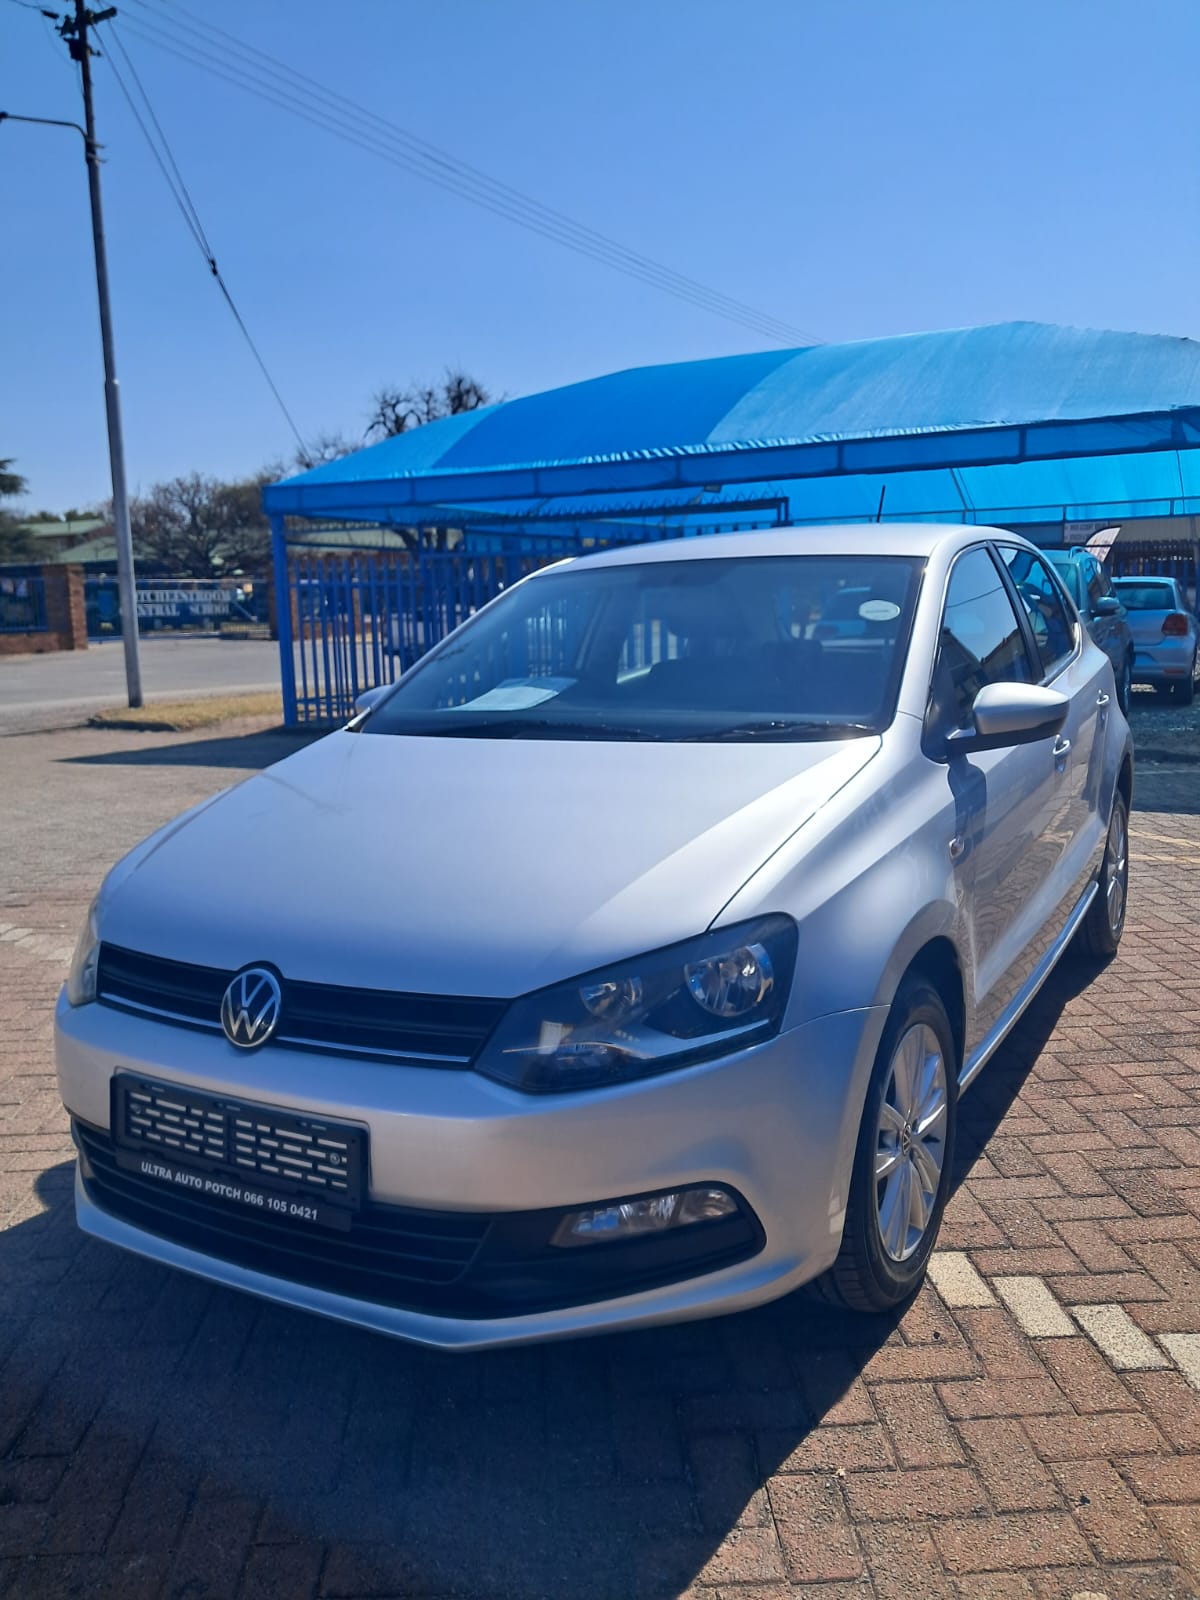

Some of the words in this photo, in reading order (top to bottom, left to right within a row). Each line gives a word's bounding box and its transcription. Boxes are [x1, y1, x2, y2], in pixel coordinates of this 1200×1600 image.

[140, 1161, 172, 1181] ULTRA
[174, 1171, 203, 1189] AUTO
[204, 1180, 241, 1200] POTCH
[243, 1191, 264, 1206] 066
[267, 1198, 287, 1213] 105
[290, 1204, 318, 1221] 0421
